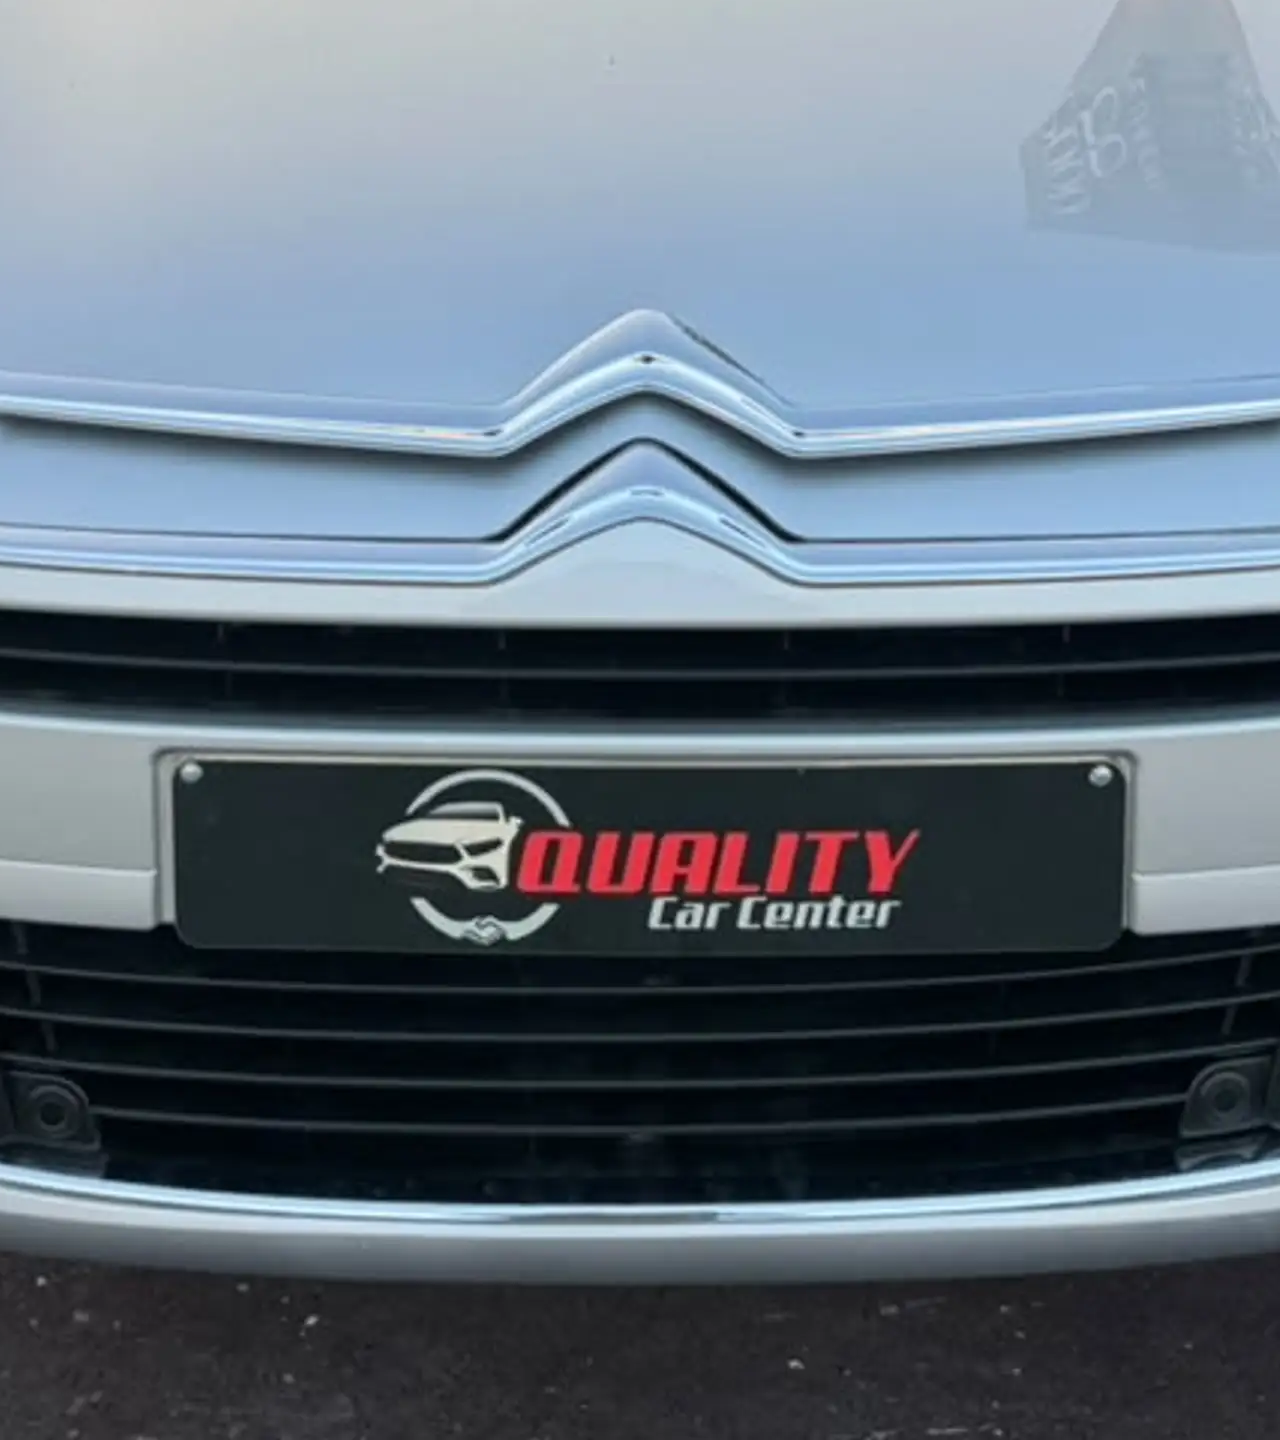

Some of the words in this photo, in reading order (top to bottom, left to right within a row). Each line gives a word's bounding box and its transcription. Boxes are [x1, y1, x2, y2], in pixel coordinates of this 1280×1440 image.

[517, 828, 920, 896] QUALITY
[647, 895, 730, 931] Car
[736, 894, 902, 931] Center
